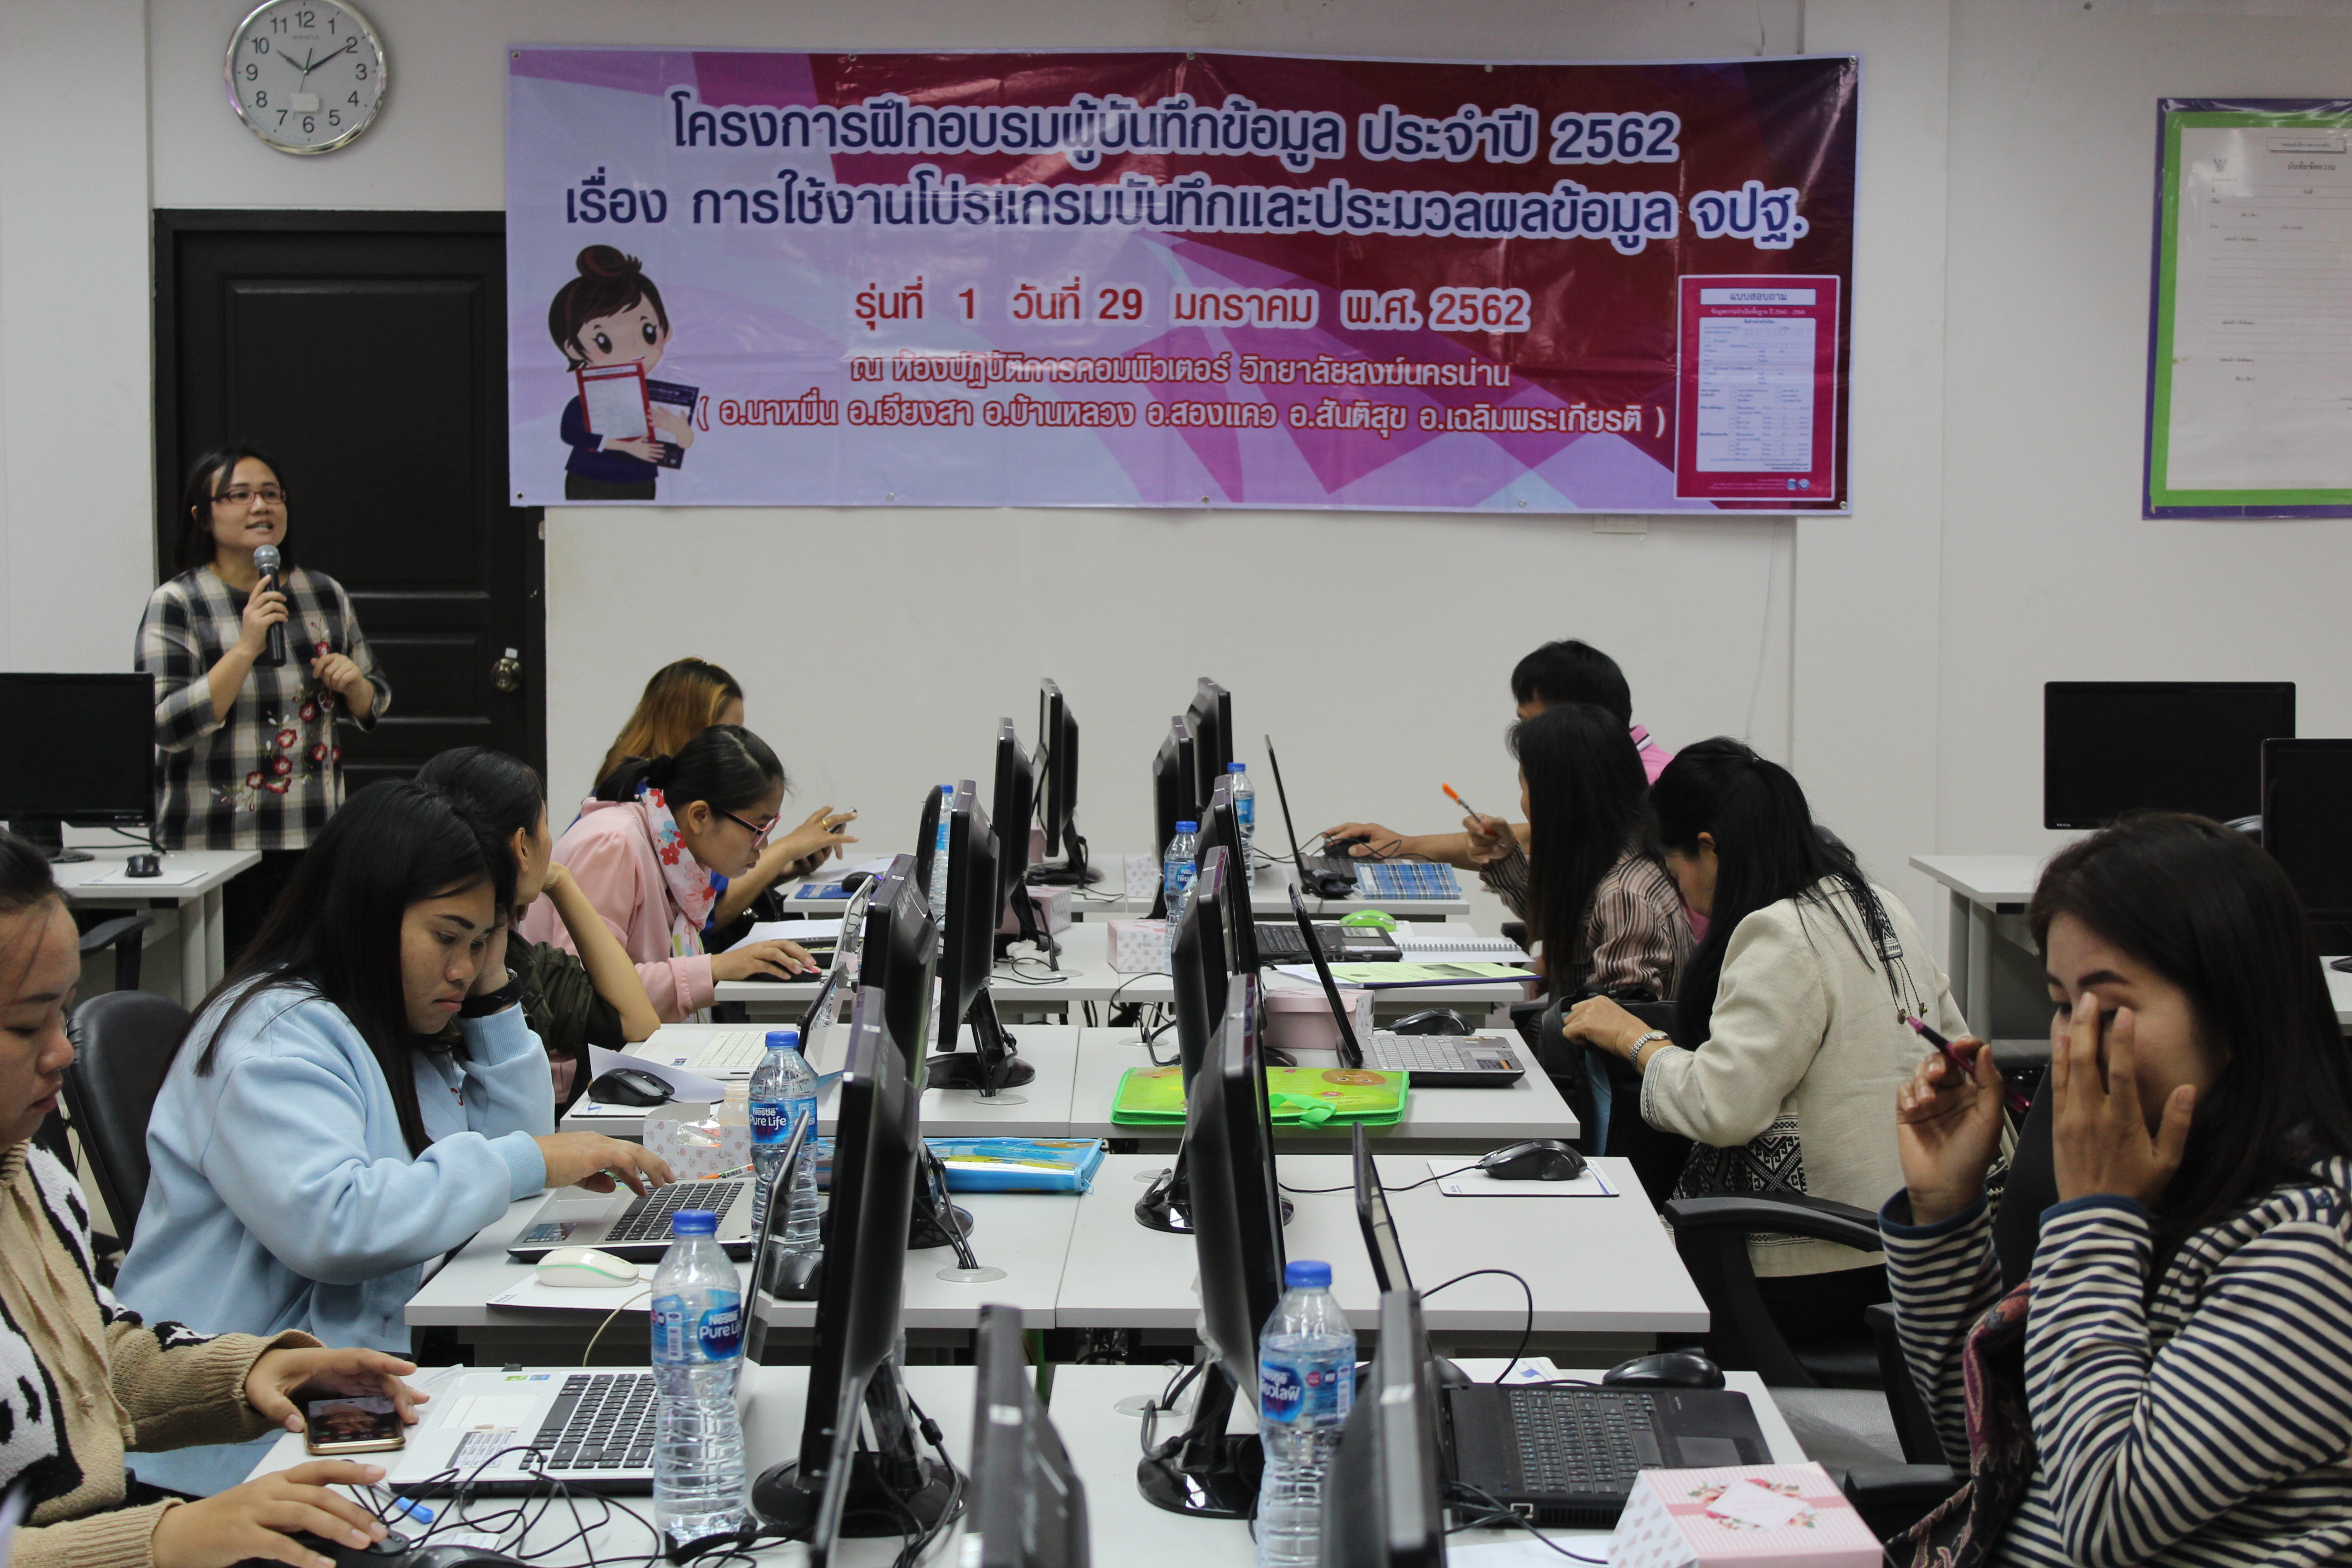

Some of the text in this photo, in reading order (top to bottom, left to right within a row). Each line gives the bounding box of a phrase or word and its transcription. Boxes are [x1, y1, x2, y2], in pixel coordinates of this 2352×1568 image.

[270, 17, 287, 34] 11
[295, 11, 315, 28] 12
[328, 18, 335, 34] 1
[251, 37, 269, 54] 10
[345, 37, 358, 53] 2
[246, 64, 258, 81] 9
[356, 64, 368, 80] 3
[256, 91, 268, 107] 8
[348, 91, 359, 107] 4
[276, 110, 288, 125] 7
[303, 116, 314, 133] 6
[329, 110, 340, 126] 5
[671, 91, 1675, 167] โครงการฝึกอบรมผู้บันทึกข้อมูล ประจำปี 2562
[567, 166, 1803, 248] เรื่อง การใช้งานโปรแกรมบันทึกและประมวลผลข้อมูล จปฐ.
[855, 275, 1524, 331] รุ่นที่ 1 วันที่ 29 มกราคม พ.ศ. 2562
[850, 348, 1511, 389] ณ ห้องปฏิบัติการคอมพิวเตอร์ วิทยาลัยสงฆ์นครน่าน
[720, 387, 839, 426] อ.นาหมื่น
[847, 392, 974, 426] อ.เวียงสา
[983, 393, 1136, 427] อ.บ้านหลวง
[1146, 401, 1278, 428] อ.สองแคว
[1289, 398, 1408, 439] อ.สันติสุข
[1418, 401, 1643, 433] อ.เฉลิมพระเกียรติ
[753, 1107, 776, 1116] Nestlé
[750, 1114, 787, 1130] Pure Life
[699, 1325, 730, 1339] Pure
